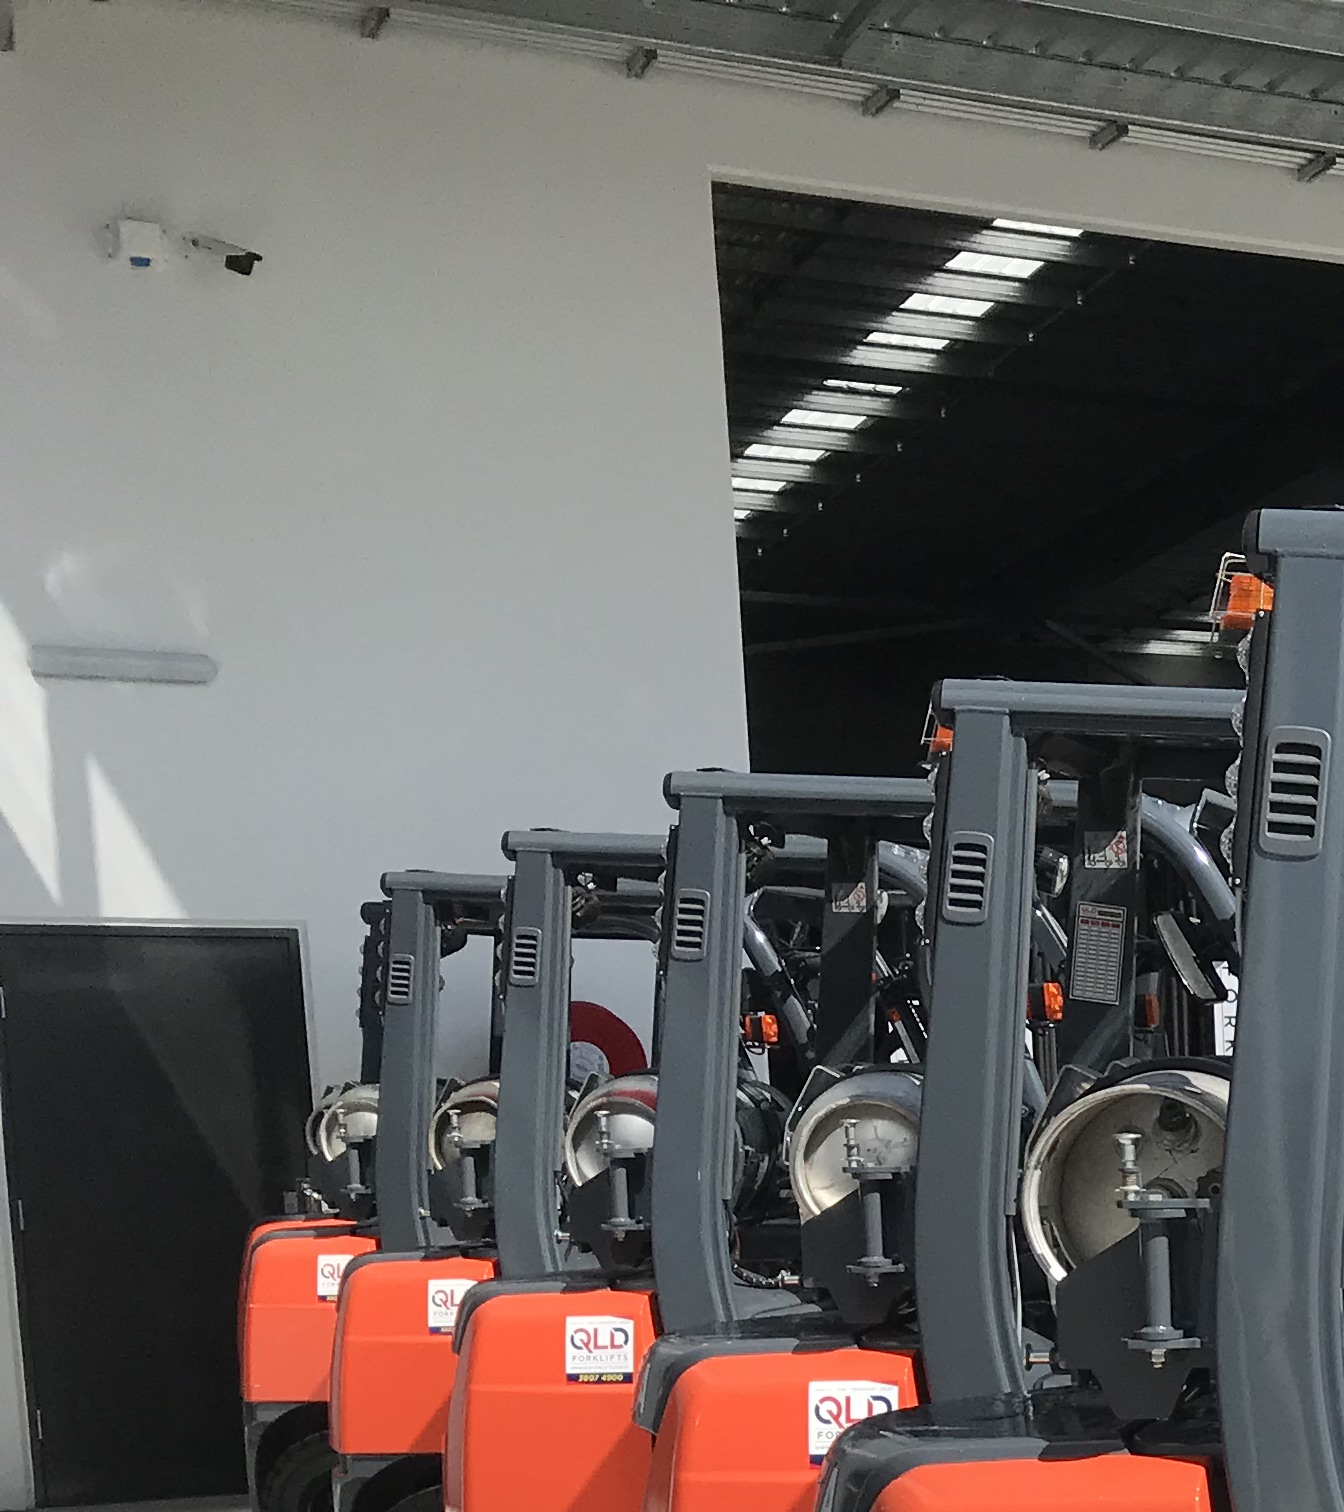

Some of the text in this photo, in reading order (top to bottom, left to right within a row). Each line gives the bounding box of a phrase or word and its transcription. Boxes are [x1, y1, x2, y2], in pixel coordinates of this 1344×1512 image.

[320, 1263, 342, 1281] QL
[431, 1289, 460, 1310] QL
[570, 1327, 629, 1354] QLD
[571, 1354, 629, 1362] FORKLIFTS
